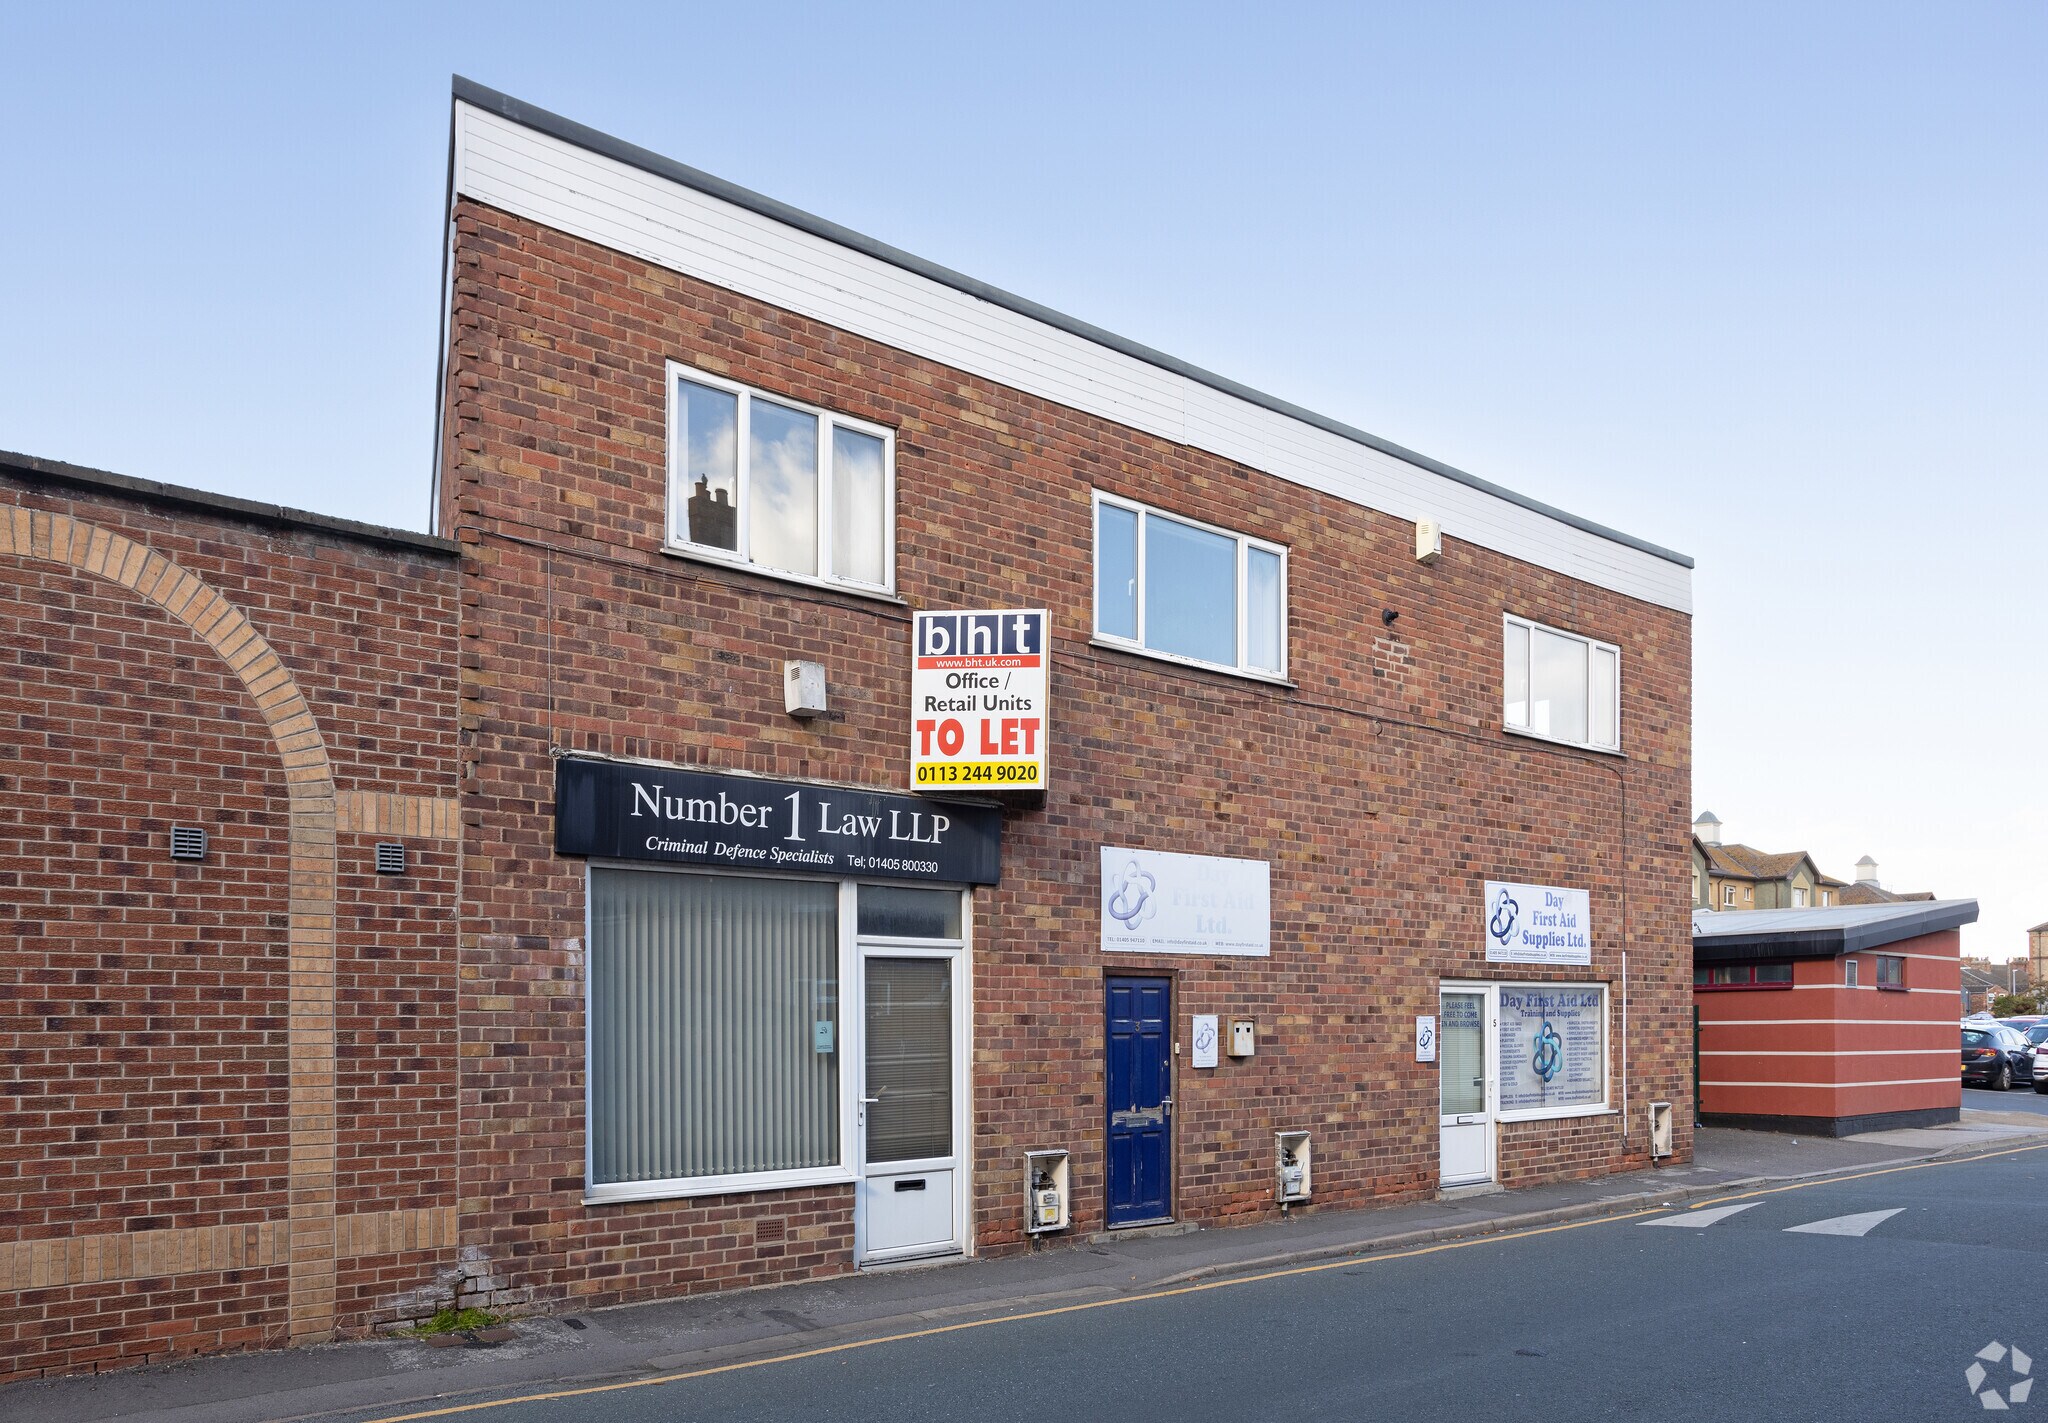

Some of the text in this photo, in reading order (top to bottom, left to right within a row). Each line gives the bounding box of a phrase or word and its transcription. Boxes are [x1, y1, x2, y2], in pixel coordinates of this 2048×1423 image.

[925, 615, 1031, 655] bht
[936, 658, 1022, 668] www.bht.uk.com
[945, 672, 999, 690] Office
[924, 694, 1032, 712] Retail Units
[916, 717, 1041, 757] TO LET
[918, 765, 1038, 781] 0113 244 9020
[630, 782, 950, 844] Number 1 Law LLP
[645, 835, 835, 865] Criminal Defence Specialists
[868, 857, 900, 871] 01405
[902, 860, 939, 873] 800330
[1171, 886, 1255, 910] First Aid
[1545, 891, 1564, 911] Day
[1195, 913, 1233, 935] Ltd.
[1532, 910, 1577, 928] First Aid
[1522, 929, 1587, 949] Supplies Ltd.
[1446, 1001, 1464, 1009] PLEASE
[1499, 992, 1599, 1010] Day First Aid Ltd
[1492, 1018, 1497, 1027] 5
[1521, 1009, 1581, 1018] Training and Supplies
[1135, 1021, 1141, 1032] 3
[1449, 1020, 1459, 1028] AND
[1459, 1020, 1480, 1028] BROWSE
